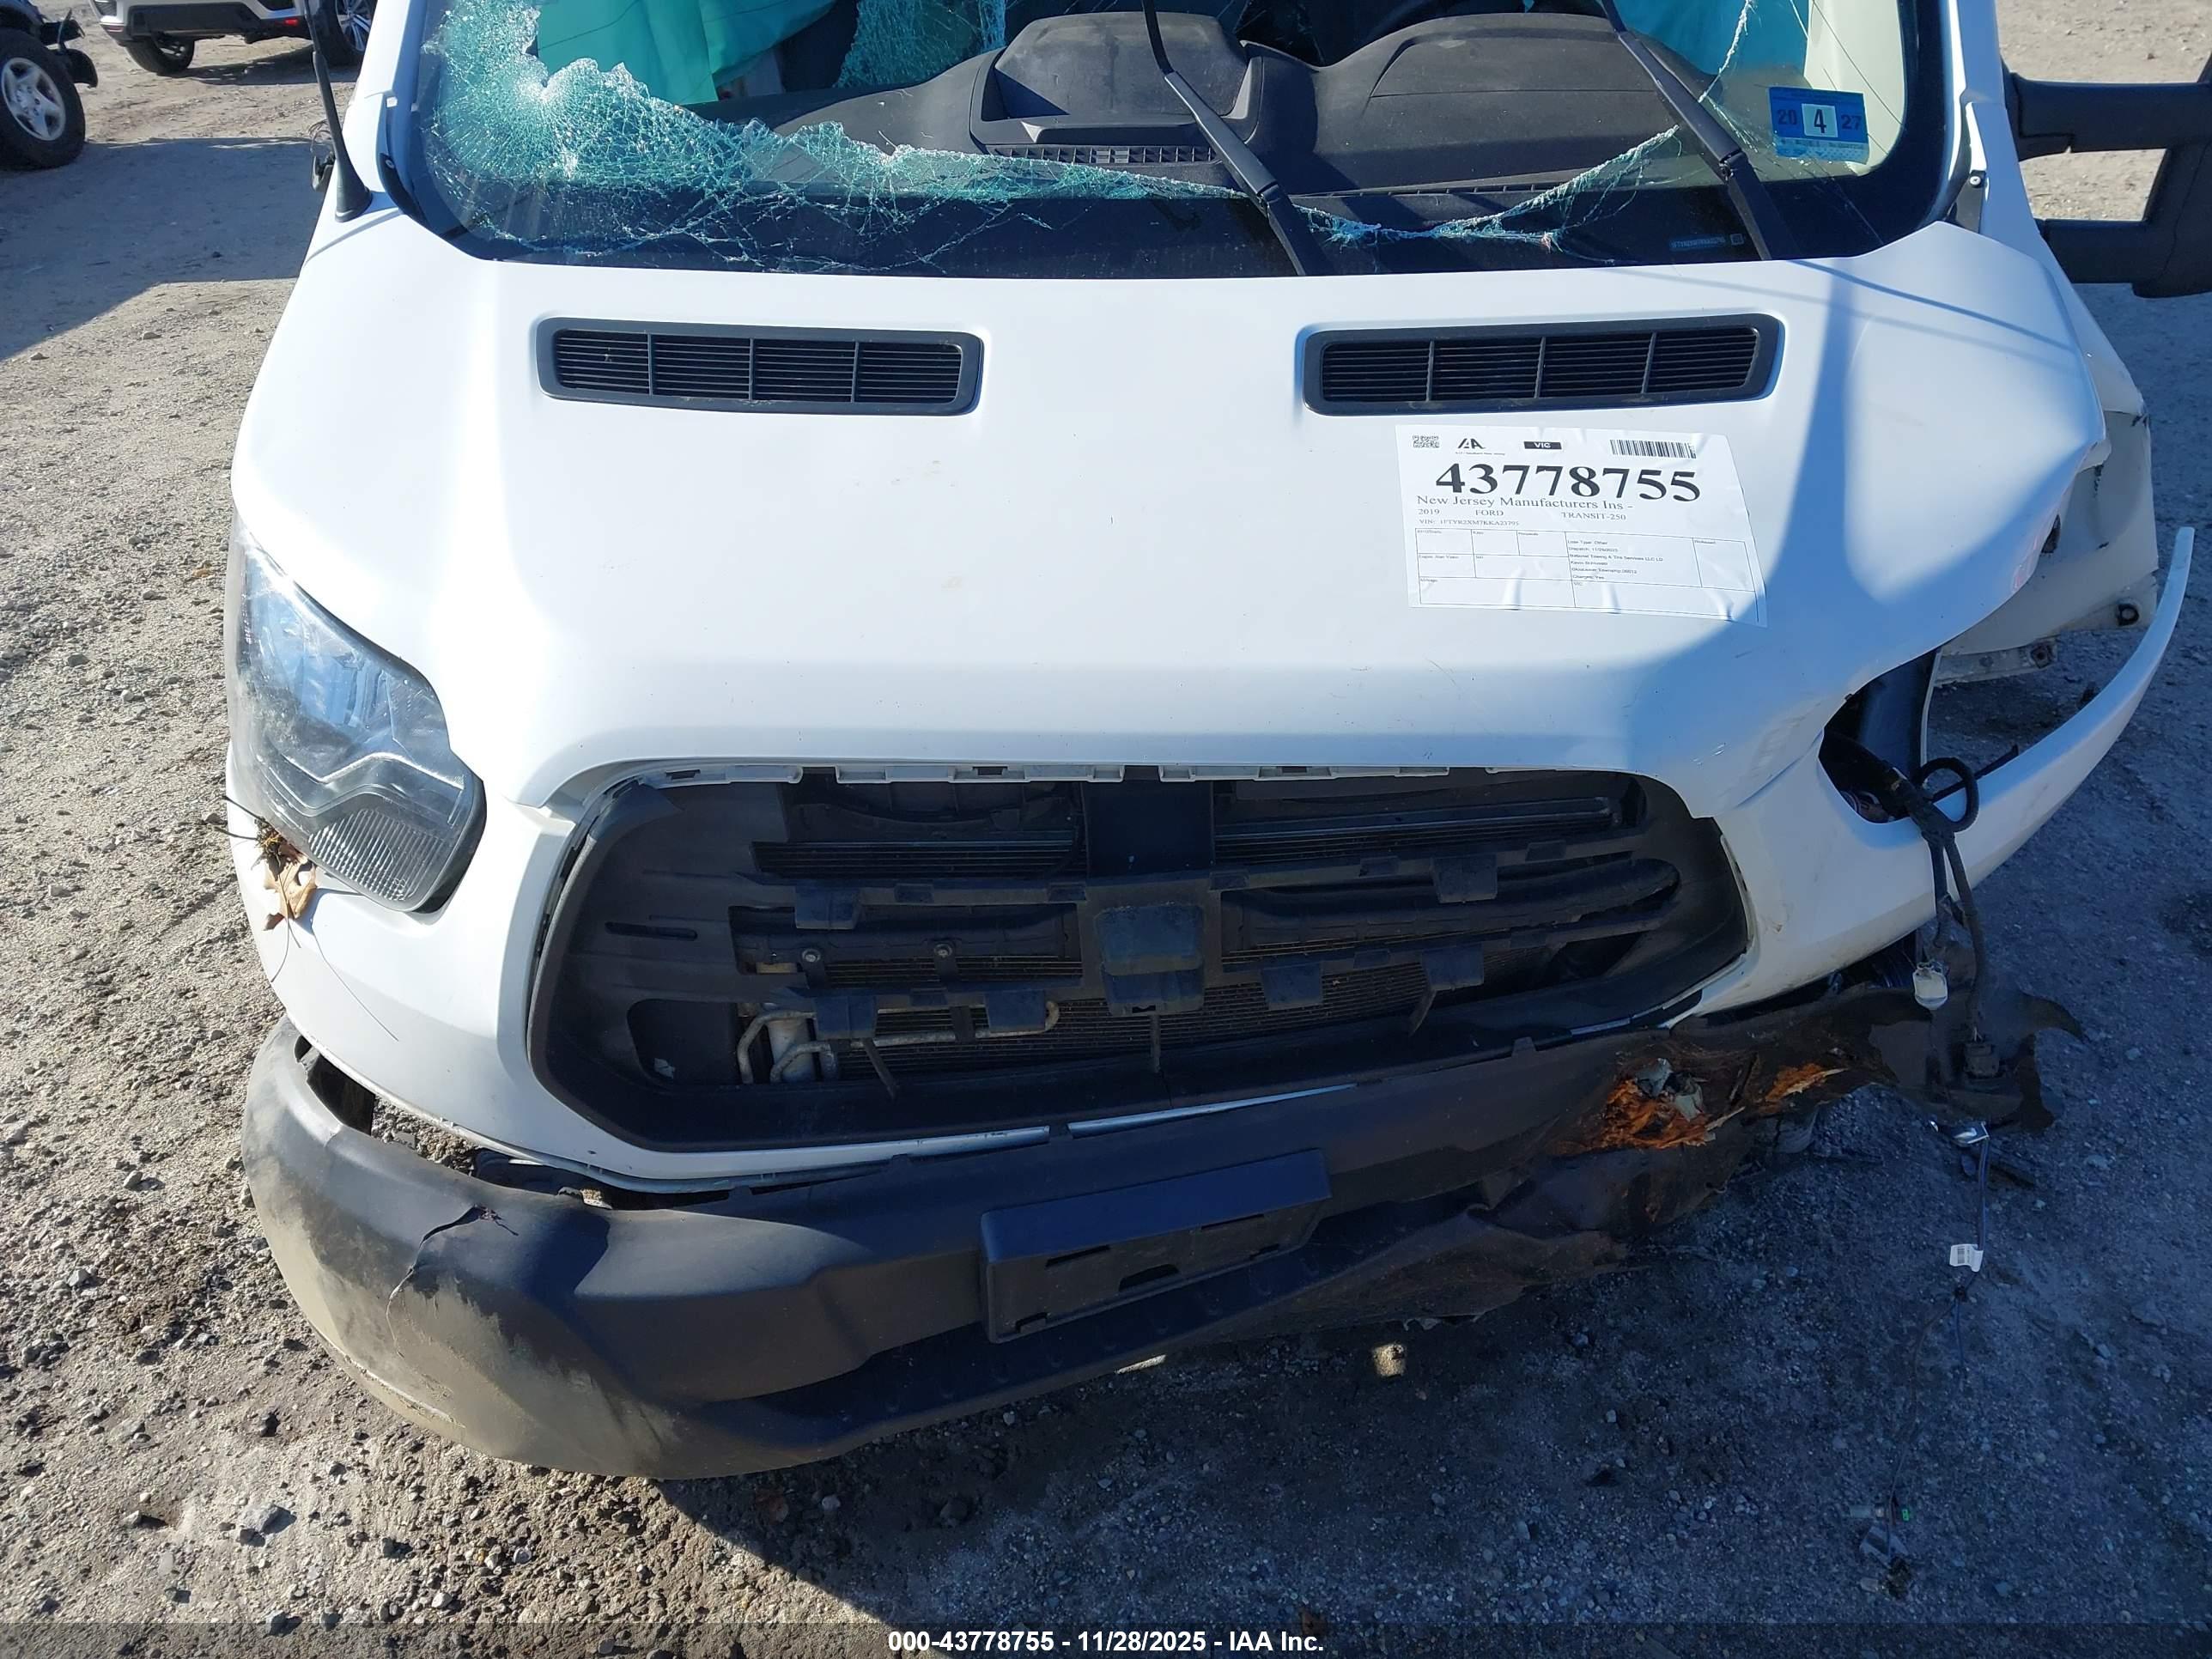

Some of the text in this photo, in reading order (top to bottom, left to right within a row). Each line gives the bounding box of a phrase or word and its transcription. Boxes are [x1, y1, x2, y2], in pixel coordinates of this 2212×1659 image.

[1777, 108, 1863, 134] 20 4 27
[1436, 463, 1700, 502] 43778755
[1417, 495, 1449, 505] New
[1453, 496, 1495, 508] Jersey
[1500, 497, 1599, 510] Manufacturers
[1602, 500, 1624, 510] Ins
[1561, 512, 1626, 520] TRANSIT-250
